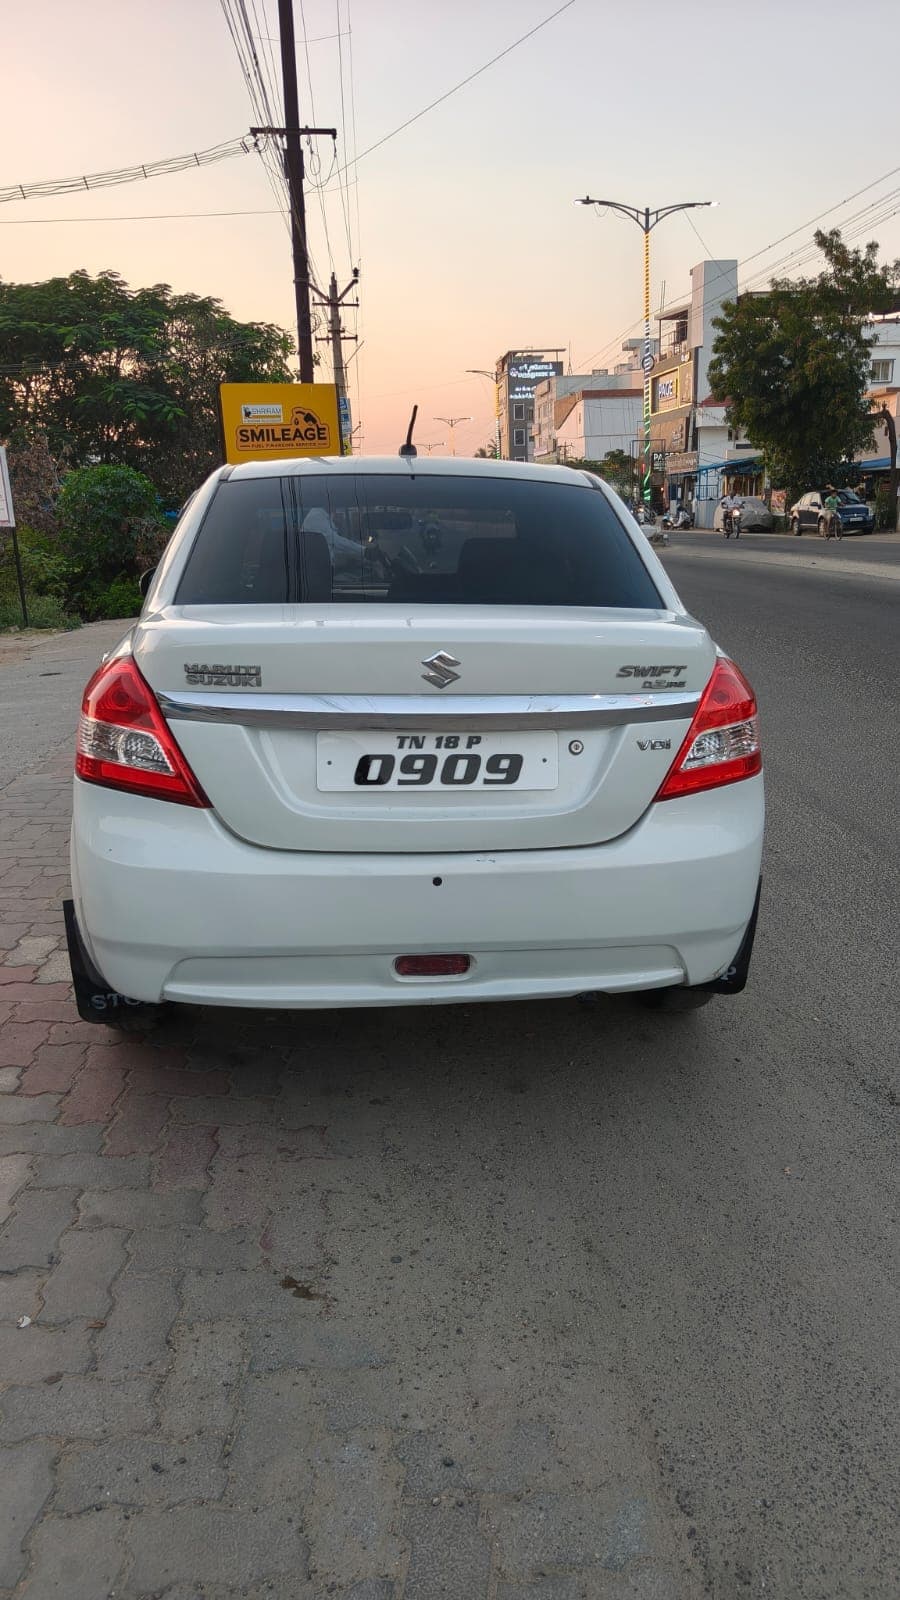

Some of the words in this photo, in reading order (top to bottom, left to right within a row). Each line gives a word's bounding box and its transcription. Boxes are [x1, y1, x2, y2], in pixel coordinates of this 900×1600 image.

[239, 427, 327, 442] SMILEAGE
[184, 664, 261, 675] MARUTI
[616, 665, 687, 678] SWIFT
[186, 674, 262, 687] SUZUKI
[396, 735, 426, 749] TN
[435, 735, 460, 749] 18
[465, 735, 482, 749] P
[353, 753, 524, 786] 0909
